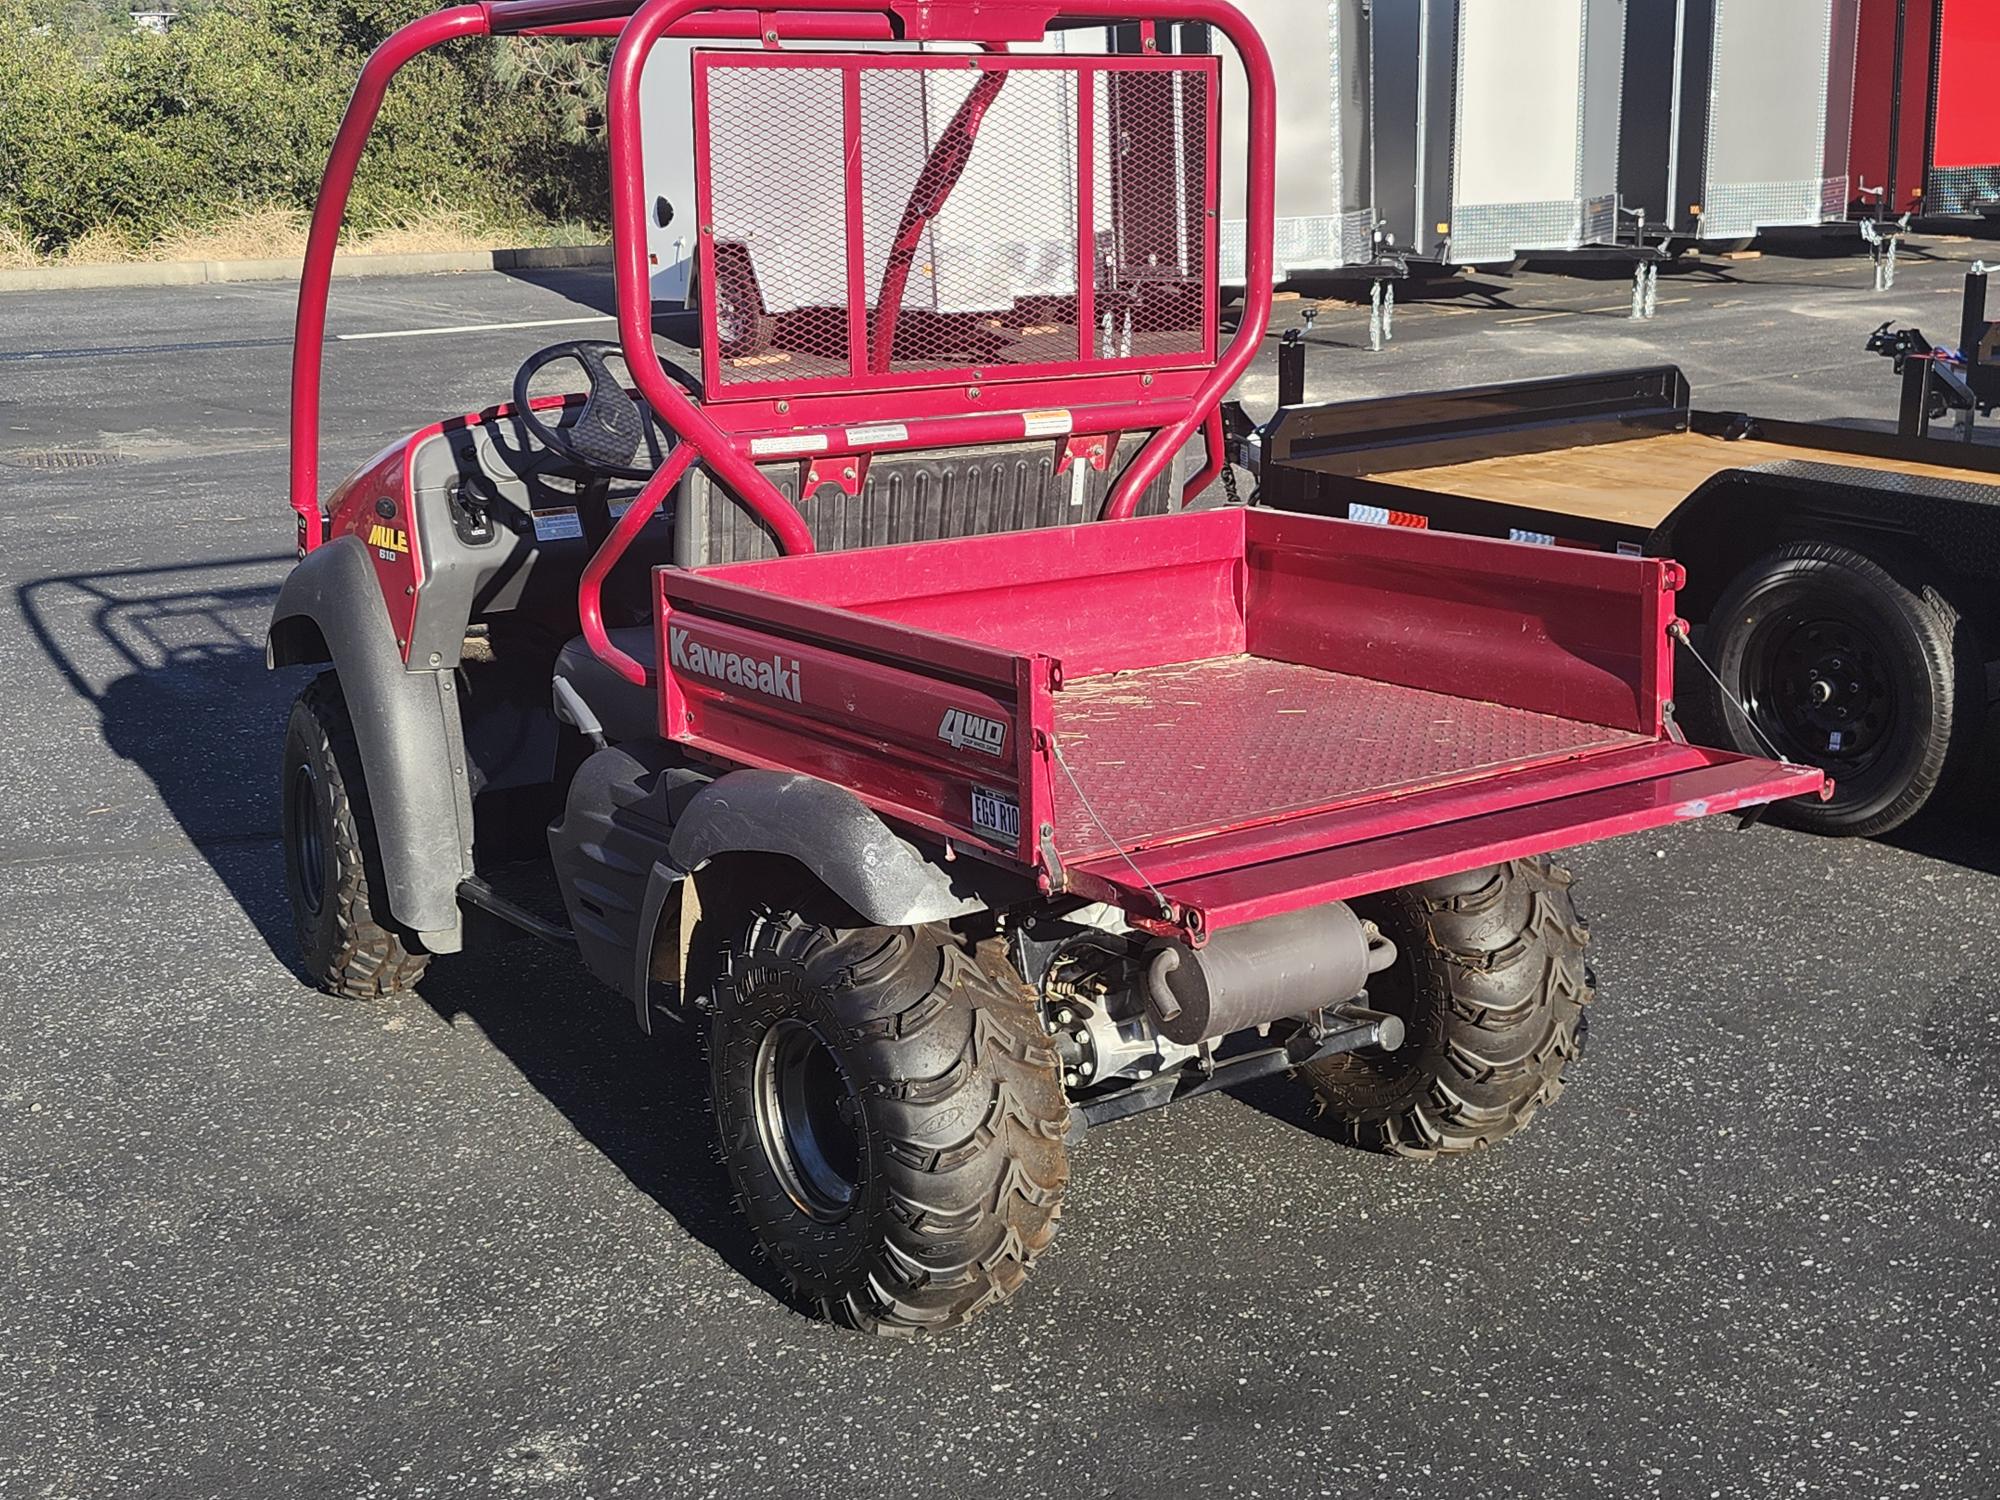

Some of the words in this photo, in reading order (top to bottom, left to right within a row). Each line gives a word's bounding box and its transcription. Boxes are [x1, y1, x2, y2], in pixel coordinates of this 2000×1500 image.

[367, 524, 409, 554] MULE
[379, 549, 396, 561] 610
[670, 626, 802, 704] Kawasaki
[938, 709, 1004, 749] 4WD
[975, 795, 996, 828] EG9
[999, 803, 1018, 835] R10
